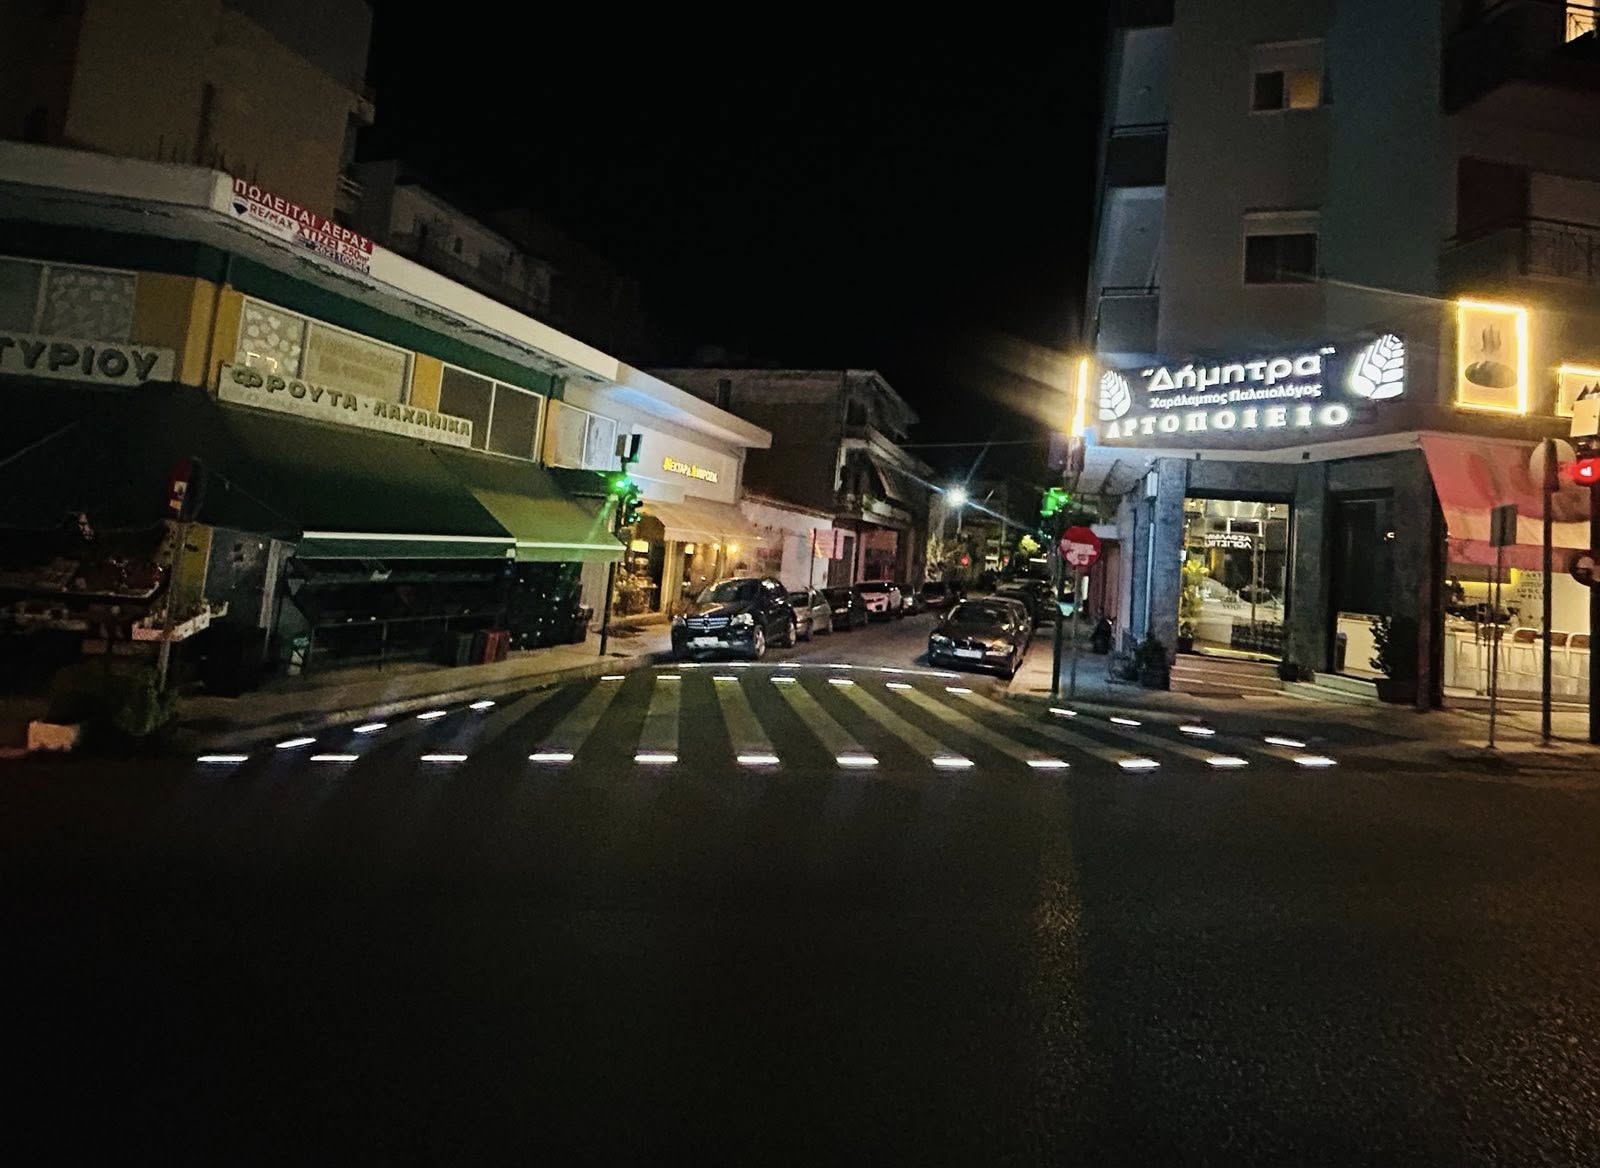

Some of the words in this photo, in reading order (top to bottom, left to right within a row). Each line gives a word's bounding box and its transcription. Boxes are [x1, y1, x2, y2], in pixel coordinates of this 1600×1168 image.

[235, 179, 315, 227] ΠΩΛΕΙΤΑΙ
[321, 221, 368, 250] ΑΕΡΑΣ
[250, 204, 293, 231] RE/MAX
[232, 362, 358, 412] ΦΡΟΥΤΑ
[373, 400, 470, 436] ΛΑΧΑΝΙΚΑ
[1151, 390, 1228, 409] Χαράλαμπος
[1229, 383, 1322, 402] Παλαιολόγος
[1105, 403, 1349, 439] ΑΡΤΟΠΟΙΕΙΟ
